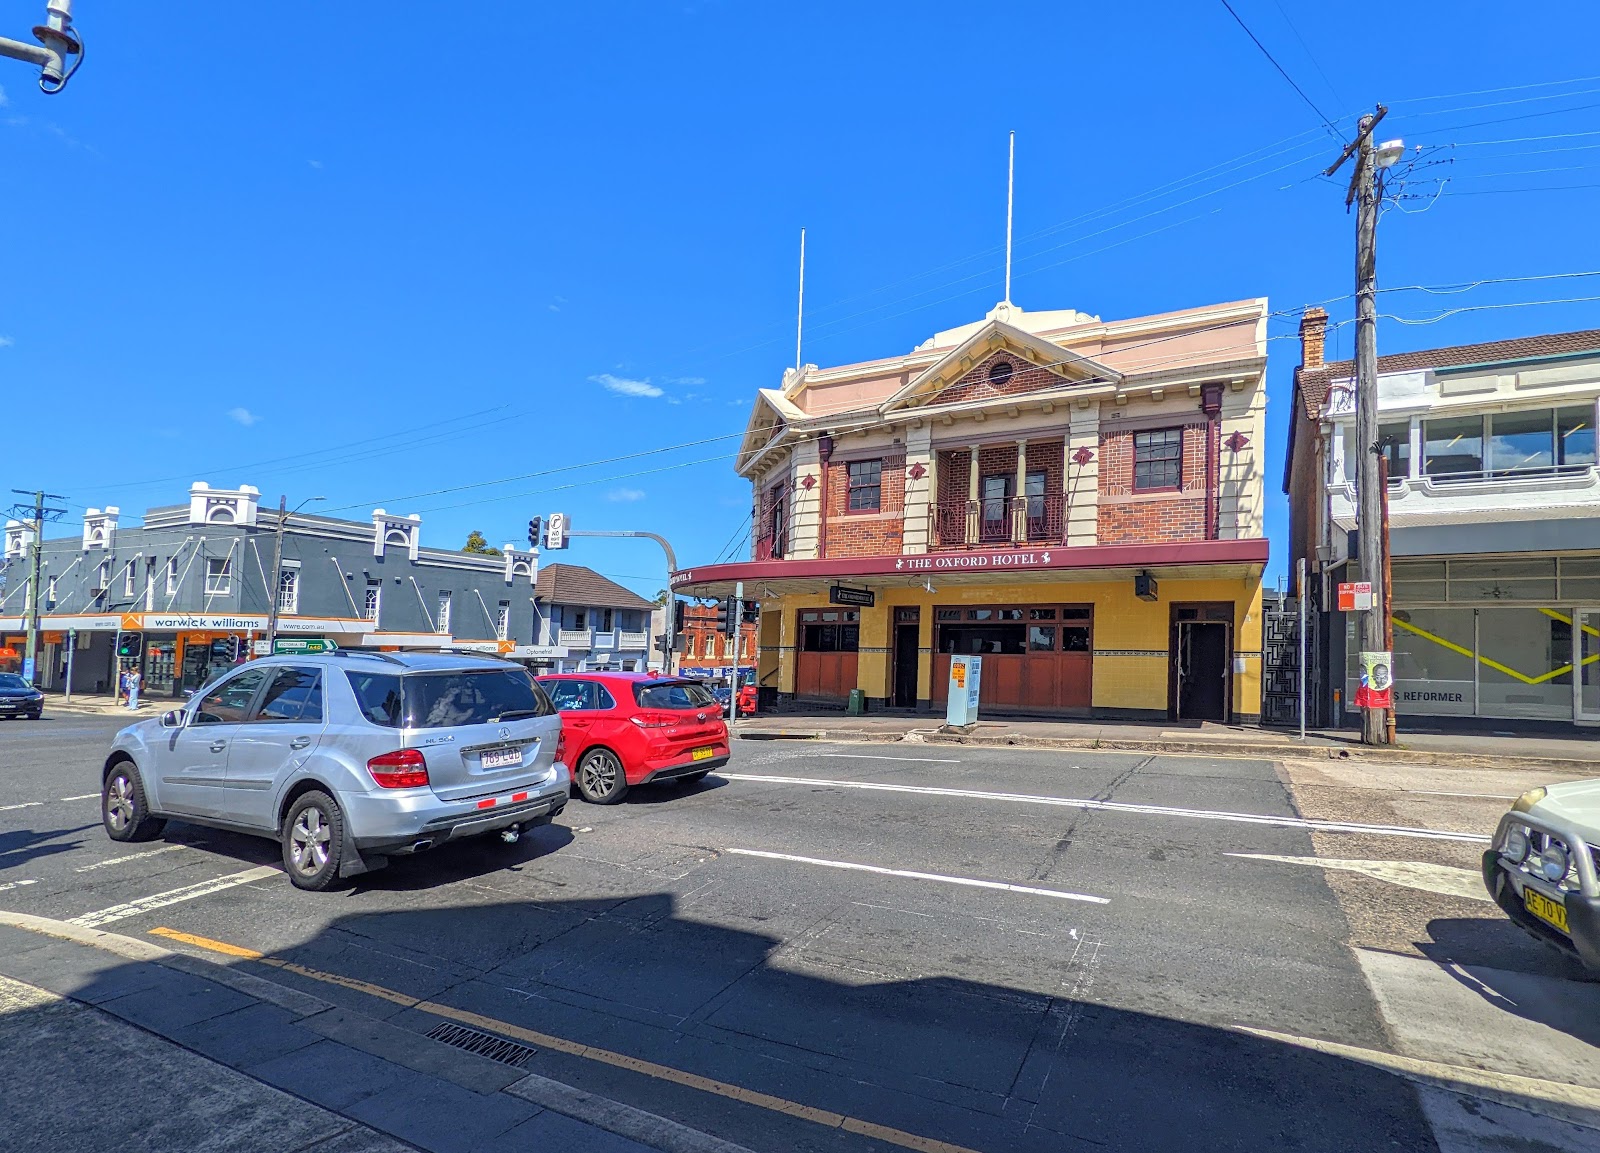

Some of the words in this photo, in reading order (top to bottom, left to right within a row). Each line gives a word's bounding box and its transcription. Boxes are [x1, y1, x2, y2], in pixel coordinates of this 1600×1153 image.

[906, 558, 932, 568] THE
[935, 556, 987, 567] OXFORD
[992, 553, 1038, 566] HOTEL
[155, 617, 207, 627] warwick
[212, 618, 259, 628] williams
[525, 648, 553, 656] Optometrist
[1403, 692, 1463, 702] REFORMER
[484, 751, 500, 765] 769
[1526, 890, 1539, 911] AE
[1541, 897, 1553, 918] 70
